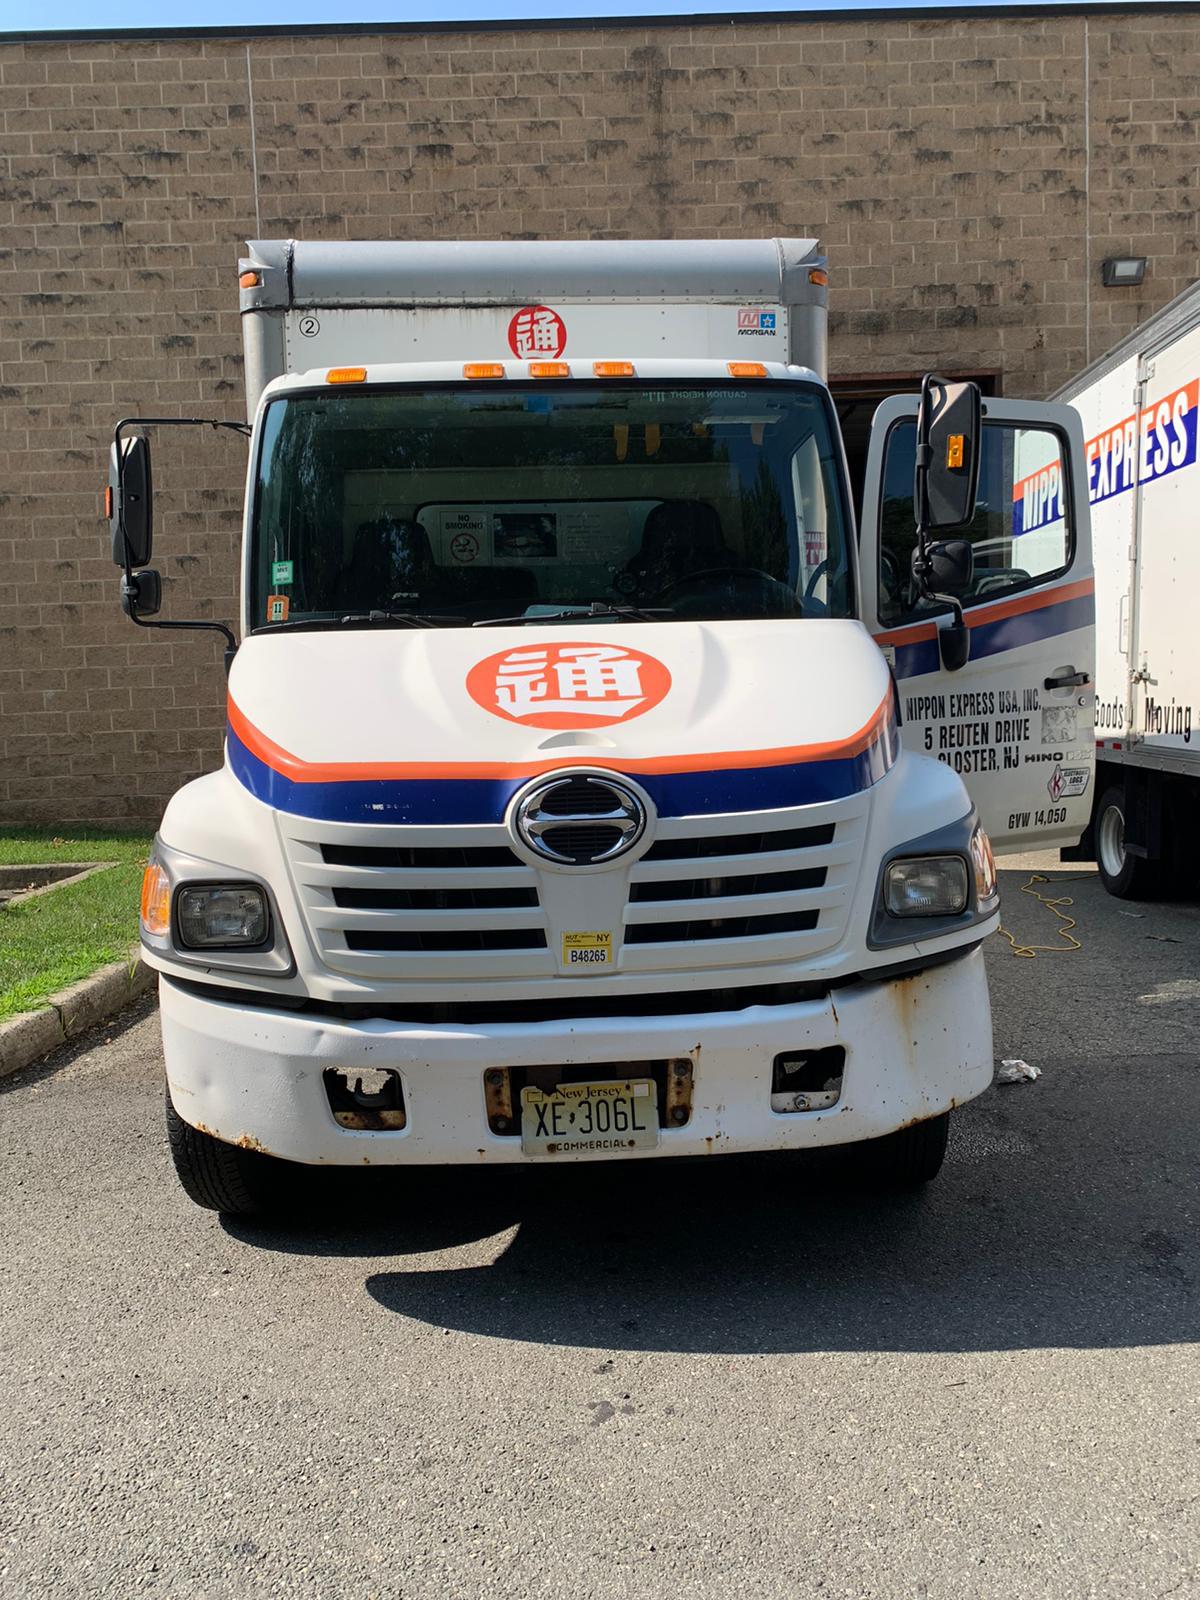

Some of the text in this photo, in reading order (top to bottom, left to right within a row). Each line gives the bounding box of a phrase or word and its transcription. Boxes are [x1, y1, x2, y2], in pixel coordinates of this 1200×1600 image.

[737, 328, 776, 336] MORGAN
[1022, 390, 1189, 532] NIPPO EXPRESS
[457, 514, 470, 522] NO
[445, 521, 484, 530] SMOKING
[495, 646, 649, 718] 通
[906, 688, 1041, 721] NIPPON EXPRESS USA, INC.
[1094, 695, 1192, 743] Goods Moving
[924, 718, 1030, 750] 5 REUTEN DRIVE
[1003, 745, 1019, 769] NJ
[1024, 752, 1063, 763] HINO
[1069, 776, 1083, 784] LOGS
[1008, 807, 1067, 829] GVW 14,050
[596, 933, 610, 942] NY
[570, 949, 606, 962] B48265
[555, 1086, 622, 1099] New Jersey
[556, 1139, 628, 1151] COMMERCIAL
